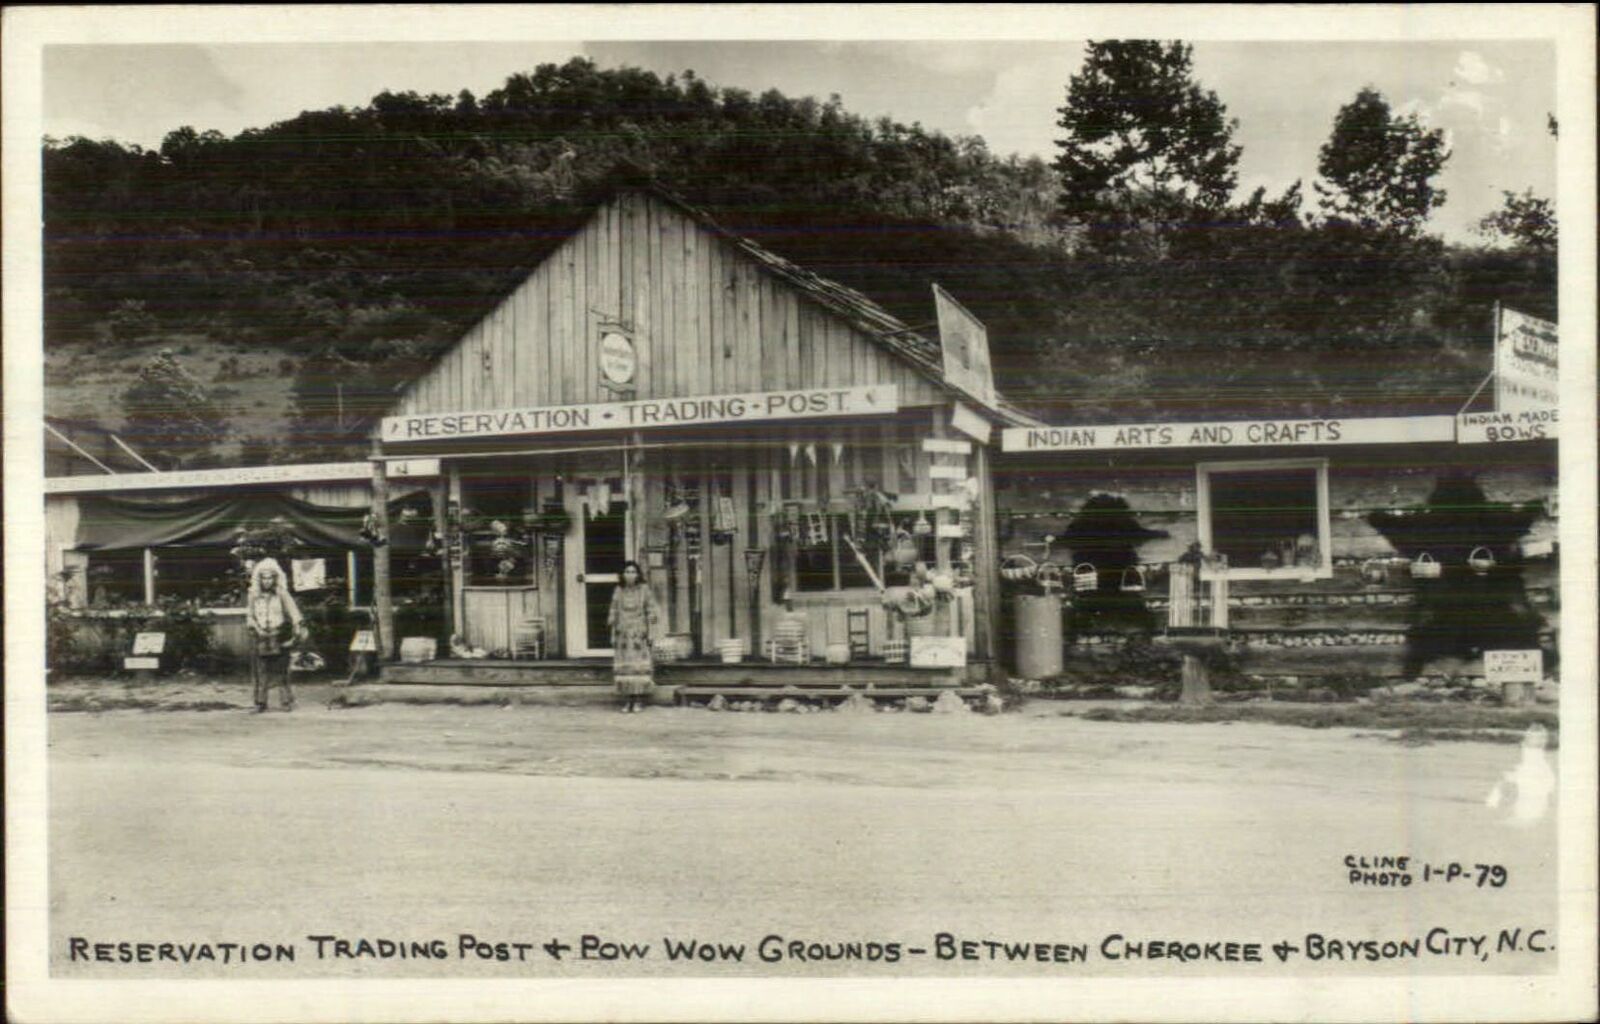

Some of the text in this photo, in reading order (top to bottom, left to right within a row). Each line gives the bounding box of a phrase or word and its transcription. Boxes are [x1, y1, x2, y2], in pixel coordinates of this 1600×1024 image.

[406, 407, 590, 437] RESERVATION
[624, 398, 745, 425] TRADING
[1463, 409, 1559, 427] INDIAN MADE
[1027, 421, 1342, 448] INDIAN ARTS AND CRAFTS
[1486, 424, 1548, 442] BOWS
